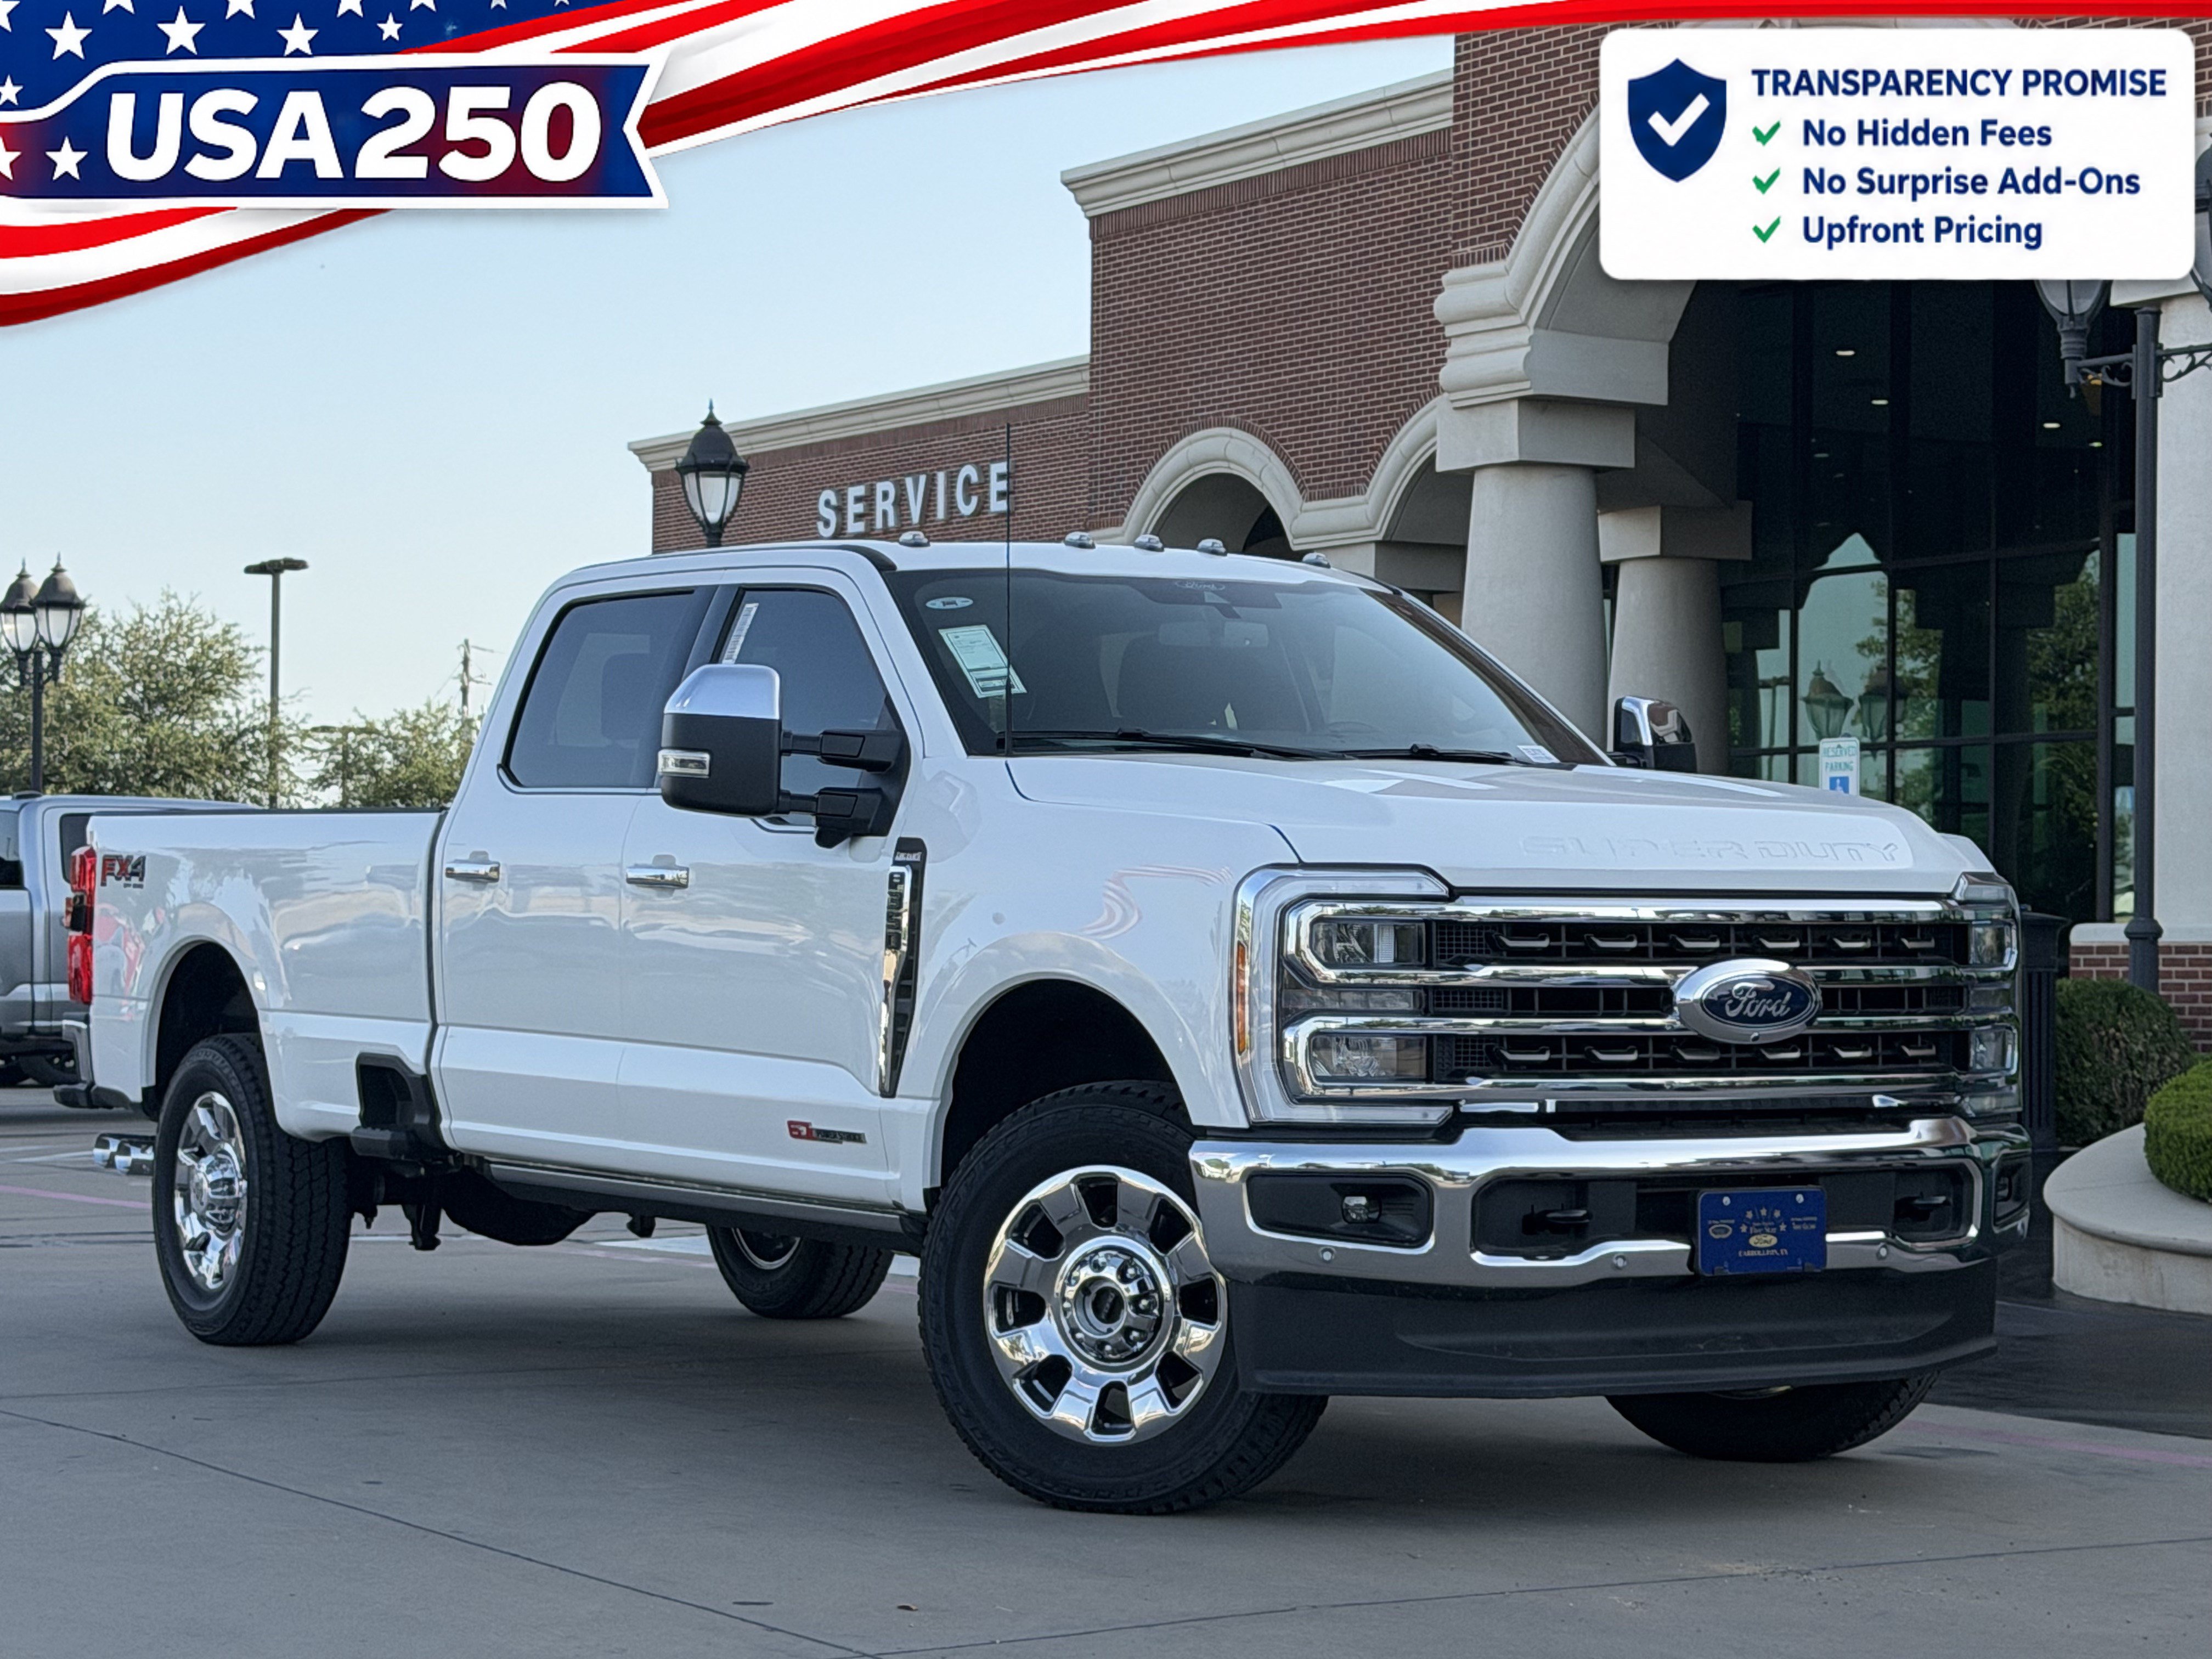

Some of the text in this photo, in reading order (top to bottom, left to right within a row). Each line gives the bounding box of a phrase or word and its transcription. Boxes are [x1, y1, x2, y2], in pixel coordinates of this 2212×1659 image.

[816, 461, 1009, 538] SERVICE
[1822, 746, 1857, 757] RESERVED
[1825, 760, 1854, 771] PARKING
[1754, 840, 1899, 862] DUTY
[100, 854, 146, 887] FX4
[1725, 979, 1792, 1018] Ford
